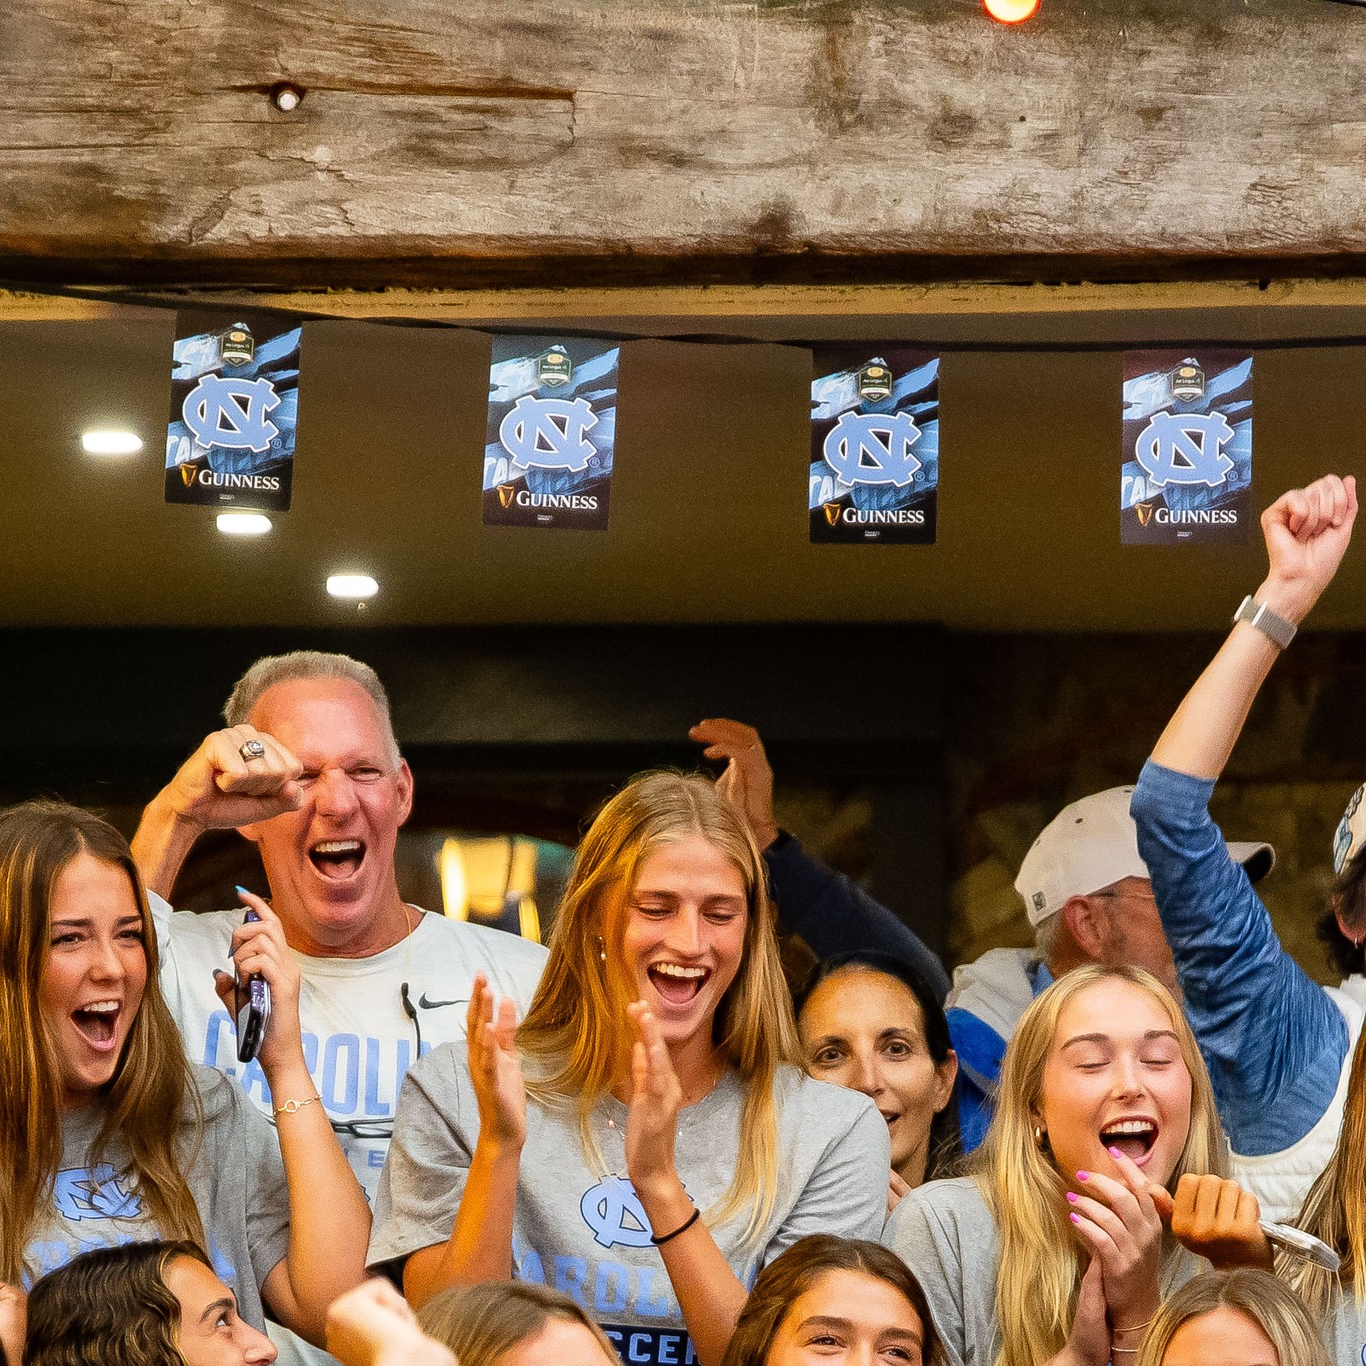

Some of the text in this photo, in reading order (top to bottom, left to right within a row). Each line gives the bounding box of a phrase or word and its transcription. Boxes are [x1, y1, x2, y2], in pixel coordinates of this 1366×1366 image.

[197, 468, 281, 491] GUINNESS
[515, 488, 599, 511] GUINNESS
[843, 505, 925, 526] GUINNESS
[1154, 506, 1238, 526] GUINNESS
